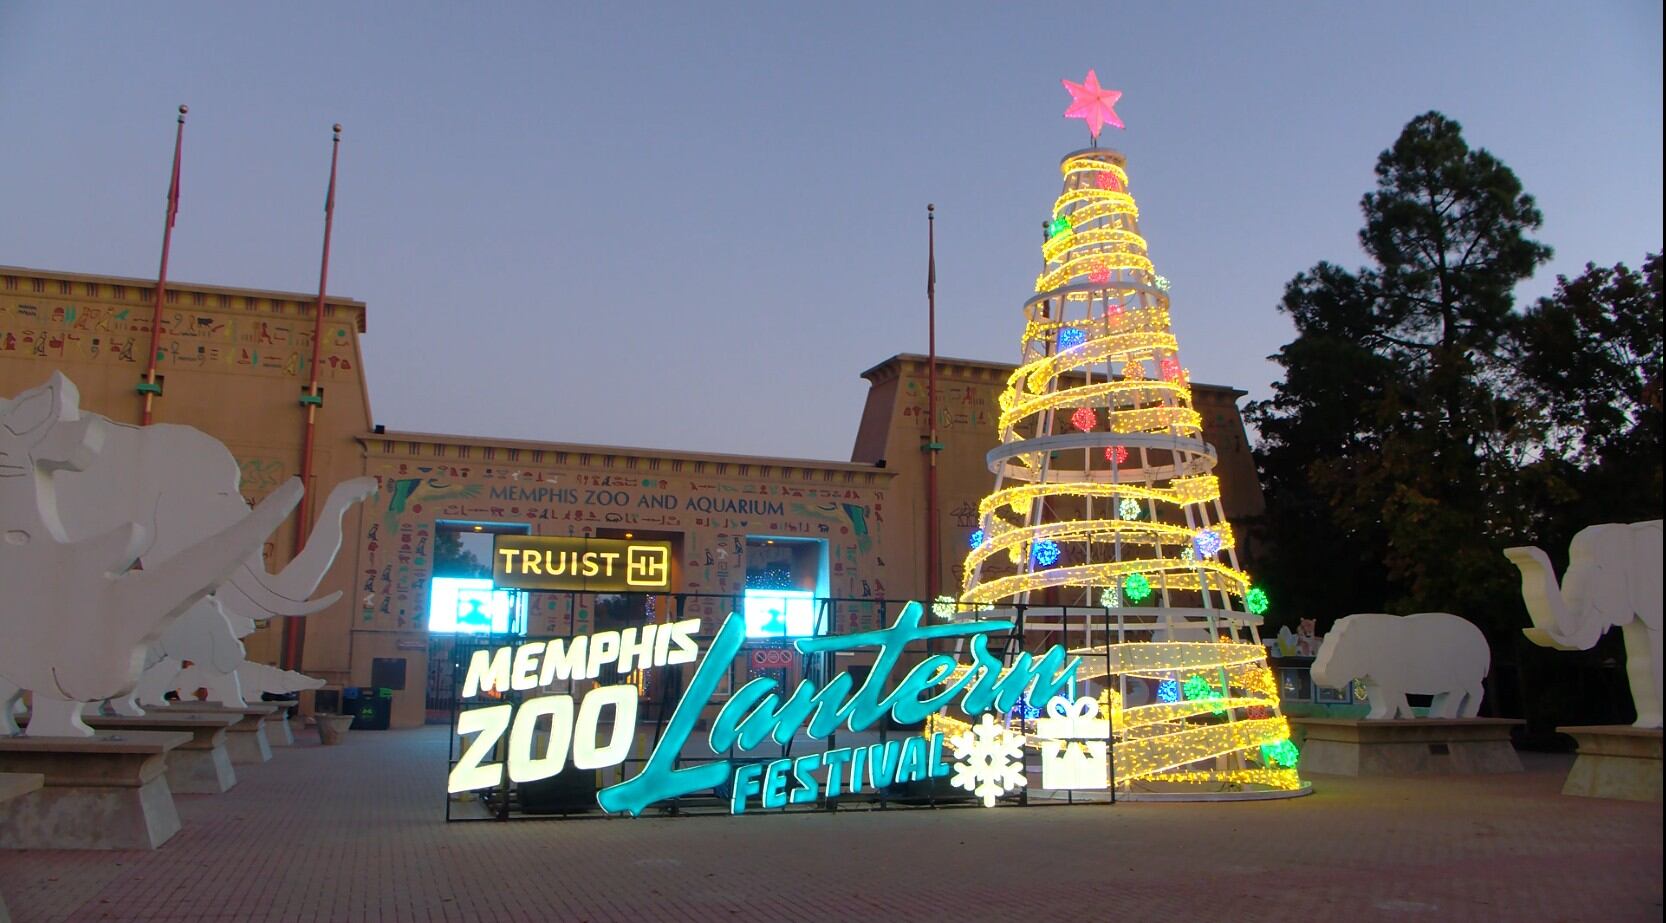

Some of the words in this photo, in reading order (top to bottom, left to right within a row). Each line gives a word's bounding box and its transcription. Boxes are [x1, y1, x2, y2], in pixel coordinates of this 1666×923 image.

[489, 485, 578, 505] MEMPHIS
[584, 489, 630, 507] ZOO
[637, 494, 678, 511] AND
[685, 496, 785, 517] AQUARIUM
[499, 548, 620, 577] TRUIST
[461, 618, 702, 698] MEMPHIS
[447, 684, 639, 794] ZOO
[596, 600, 1083, 817] Lantern
[730, 731, 951, 815] FESTIVAL
